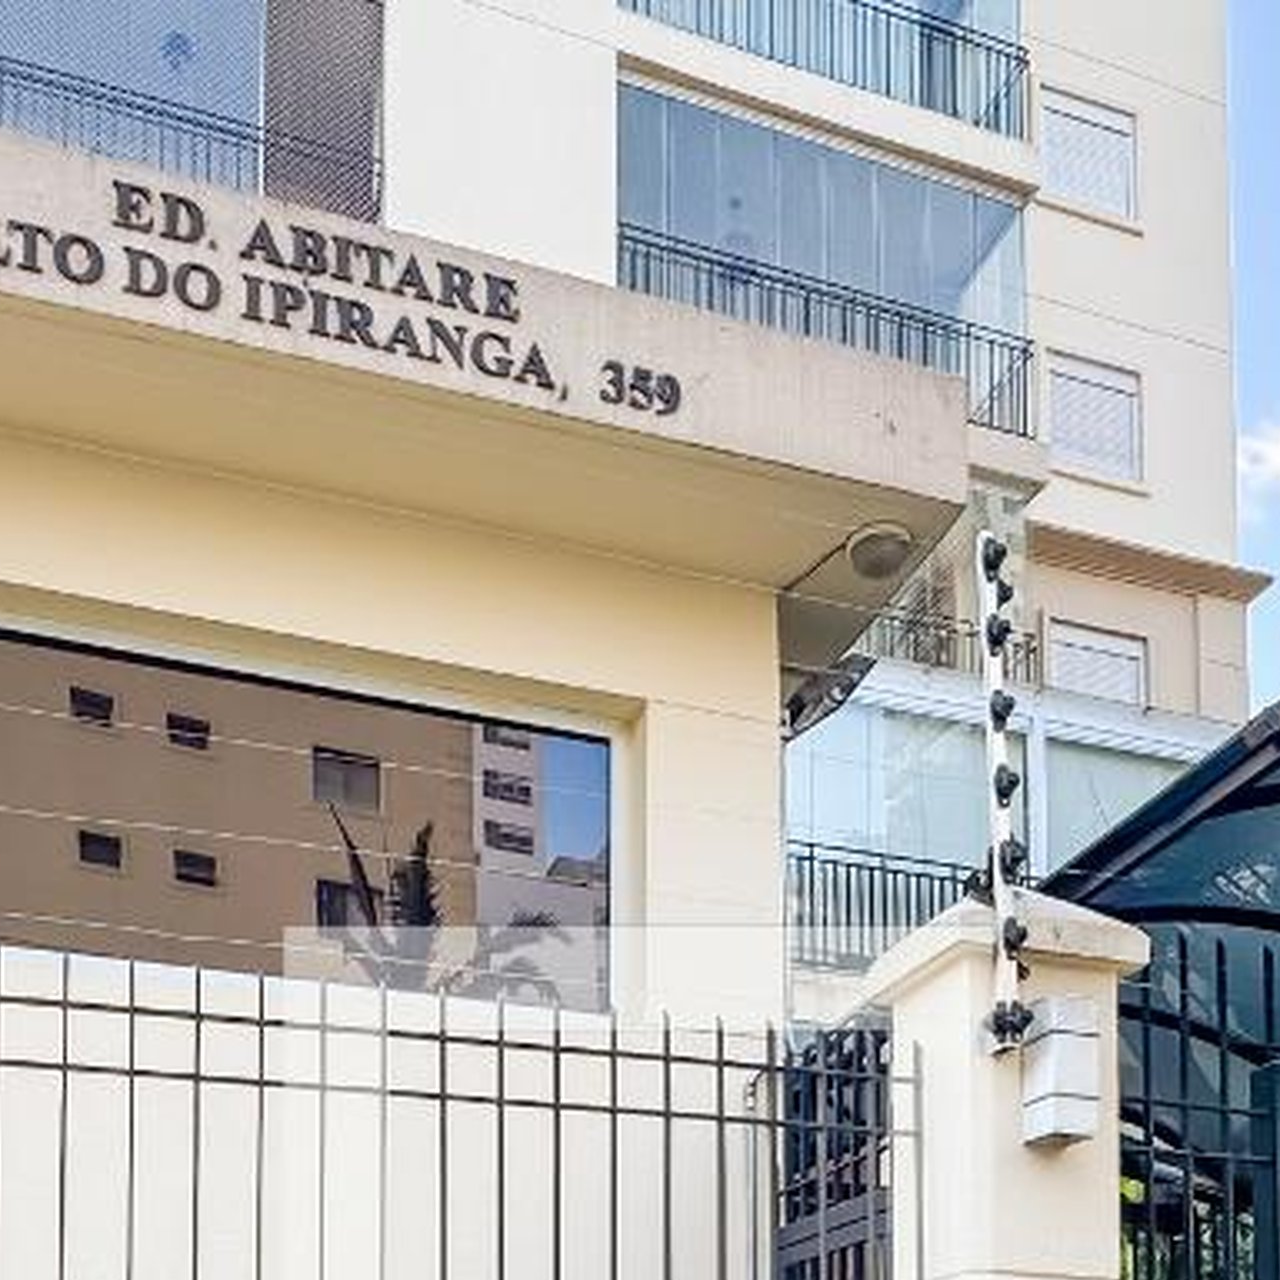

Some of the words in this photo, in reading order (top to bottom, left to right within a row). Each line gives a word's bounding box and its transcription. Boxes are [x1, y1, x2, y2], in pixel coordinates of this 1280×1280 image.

[112, 179, 216, 252] ED.
[240, 218, 519, 323] ABITARE
[122, 247, 221, 312] DO
[241, 274, 570, 401] IPIRANGA,
[599, 361, 683, 416] 359
